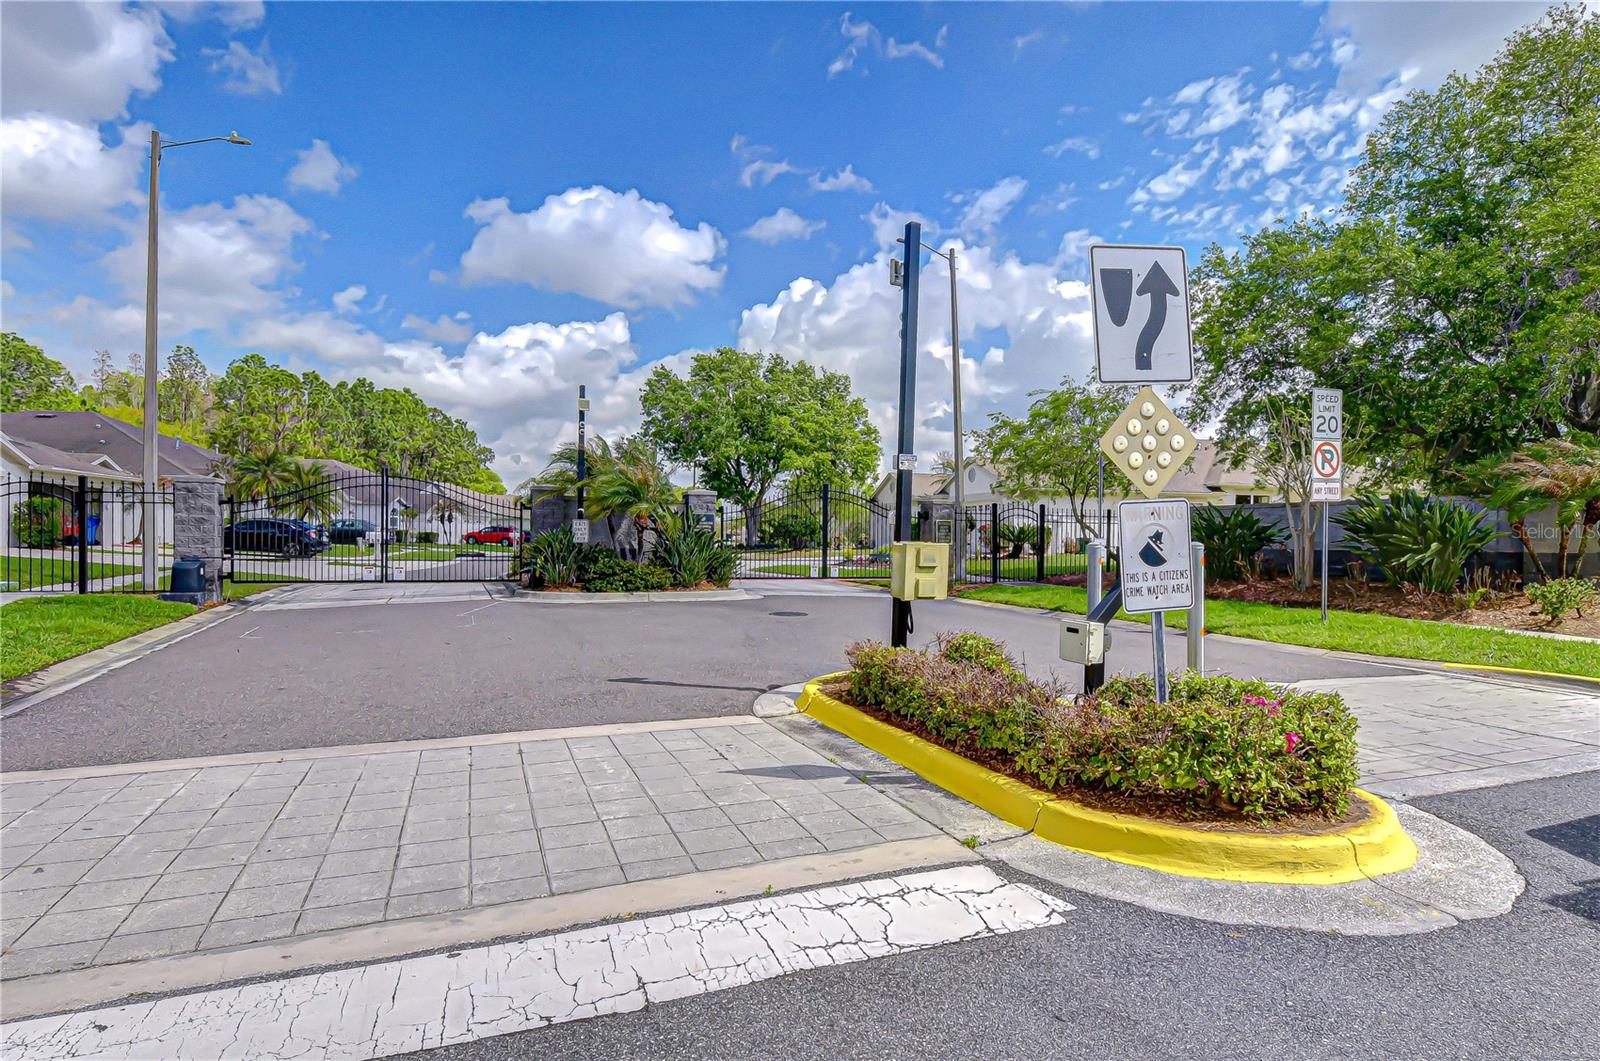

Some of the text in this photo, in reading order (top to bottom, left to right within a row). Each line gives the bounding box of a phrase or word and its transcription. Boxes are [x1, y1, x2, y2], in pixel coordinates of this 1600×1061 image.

[1316, 394, 1339, 403] SPEED
[1318, 405, 1336, 413] LIMIT
[1316, 415, 1338, 433] 20
[1324, 487, 1339, 495] STREET
[1126, 569, 1189, 583] THIS IS A CITIZENS
[1126, 583, 1190, 598] CRIME WATCH AREA
